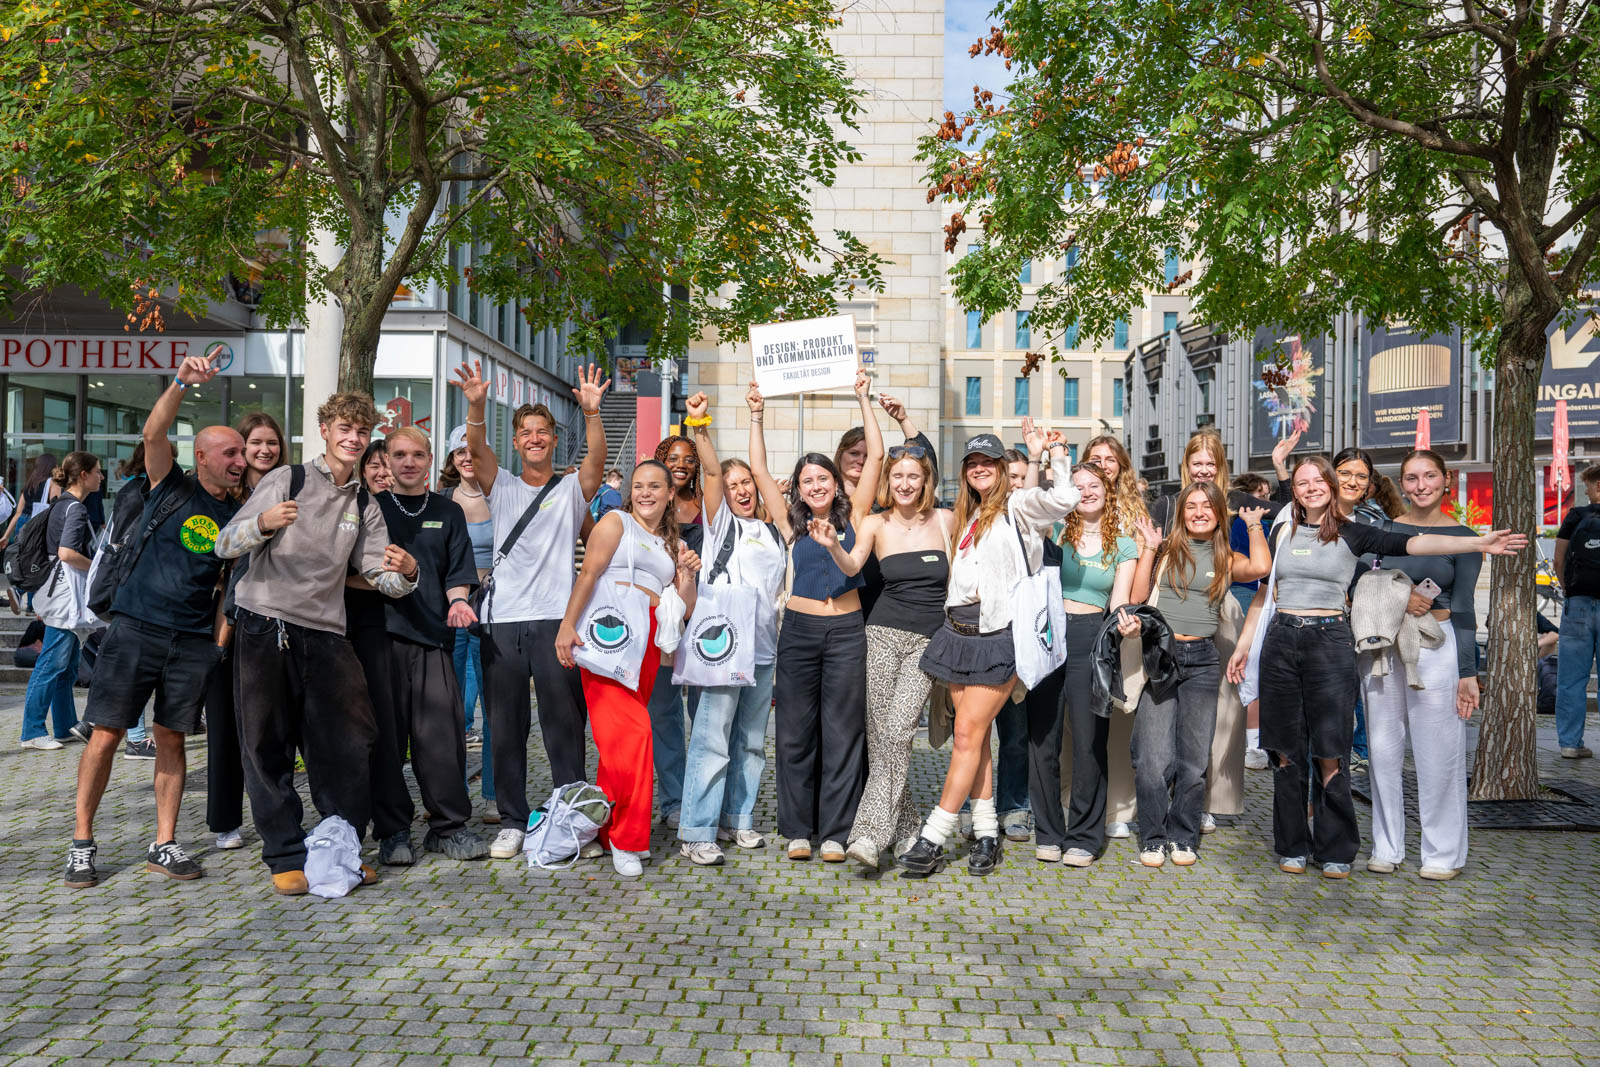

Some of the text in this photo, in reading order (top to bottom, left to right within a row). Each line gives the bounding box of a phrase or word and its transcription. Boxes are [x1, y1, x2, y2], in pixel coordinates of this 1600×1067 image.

[1, 338, 189, 369] POTHEKE
[764, 334, 844, 355] DESIGN: PRODUKT
[756, 344, 854, 367] UND KOMMUNIKATION
[783, 366, 831, 380] FAKULTÄT DESIGN
[1537, 382, 1600, 401] INGA
[1411, 412, 1443, 420] DDEN
[191, 518, 217, 536] BOSS
[183, 532, 211, 552] REGGAE
